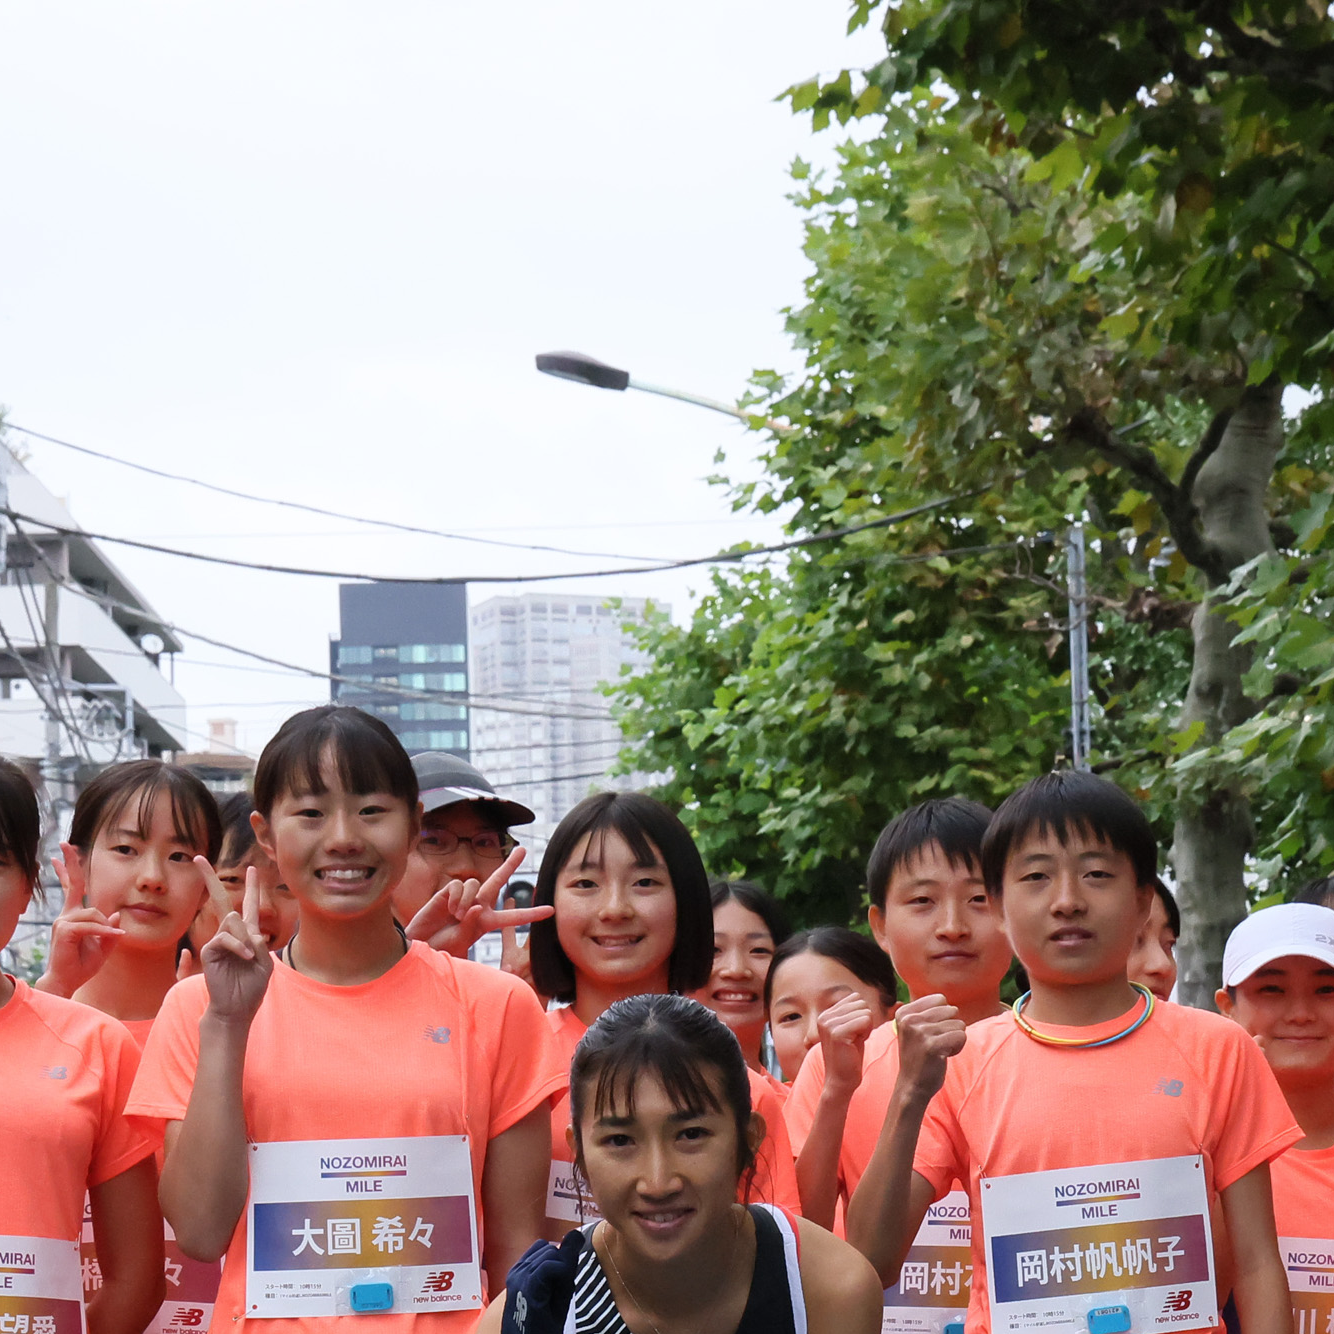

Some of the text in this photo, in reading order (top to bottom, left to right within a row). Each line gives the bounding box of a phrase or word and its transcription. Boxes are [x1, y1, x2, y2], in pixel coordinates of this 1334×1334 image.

[320, 1155, 407, 1169] NOZOMIRAI
[346, 1180, 383, 1193] MILE
[1054, 1178, 1140, 1198] NOZOMIRAI
[1082, 1204, 1118, 1220] MILE
[291, 1216, 435, 1256] 大圖 希々
[1016, 1235, 1185, 1288] 岡村帆帆子
[413, 1294, 462, 1304] new balance
[1155, 1312, 1199, 1324] new balance
